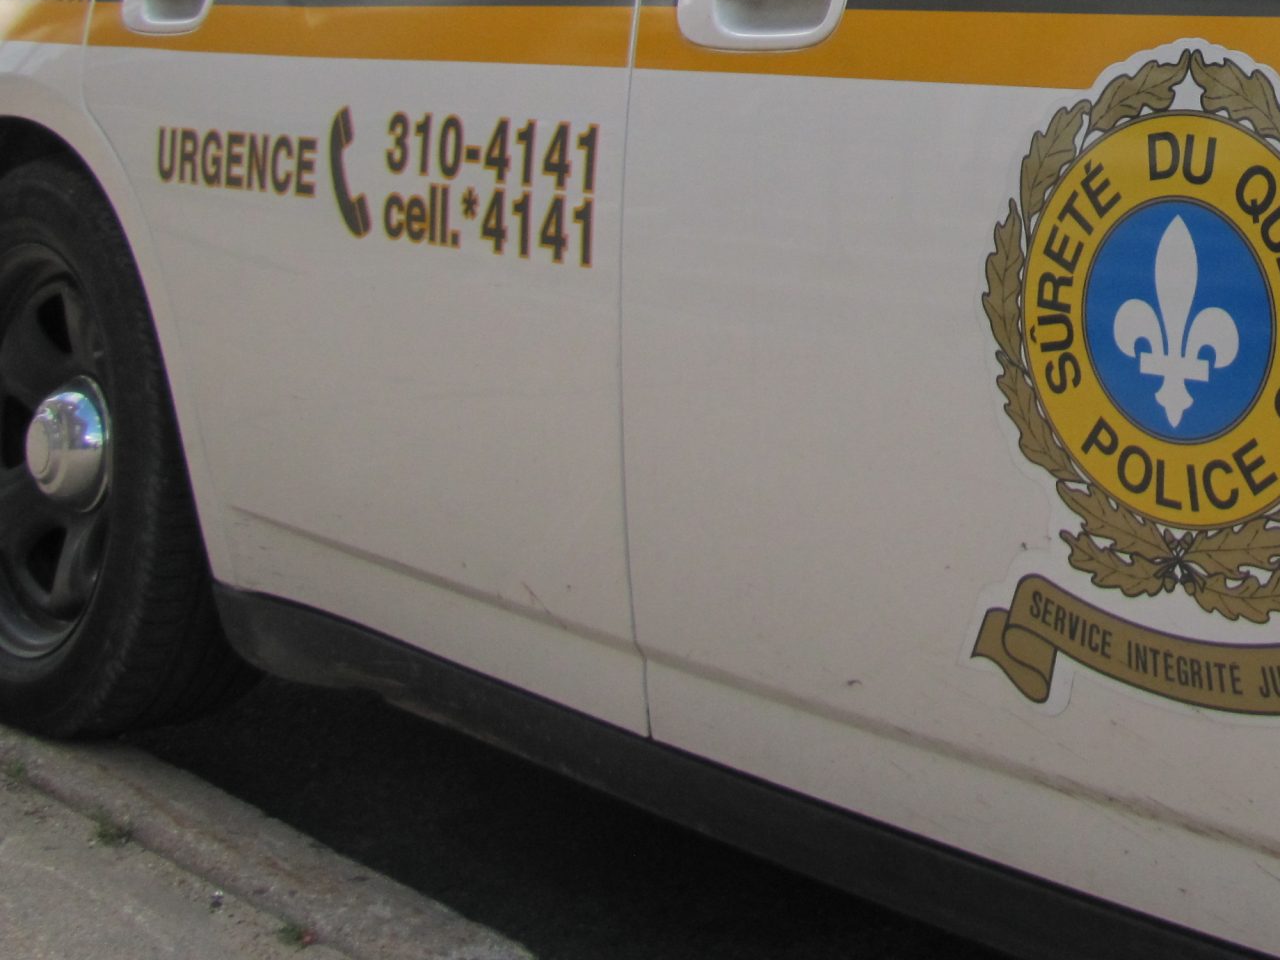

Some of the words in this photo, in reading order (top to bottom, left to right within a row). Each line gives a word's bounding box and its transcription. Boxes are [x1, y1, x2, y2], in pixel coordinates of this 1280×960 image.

[157, 125, 320, 197] URGENCE
[384, 110, 602, 196] 310-4141
[1029, 158, 1122, 396] SÛRETÉ
[1146, 130, 1219, 185] DU
[1079, 414, 1278, 512] POLICE
[1028, 589, 1113, 660] SERVICE
